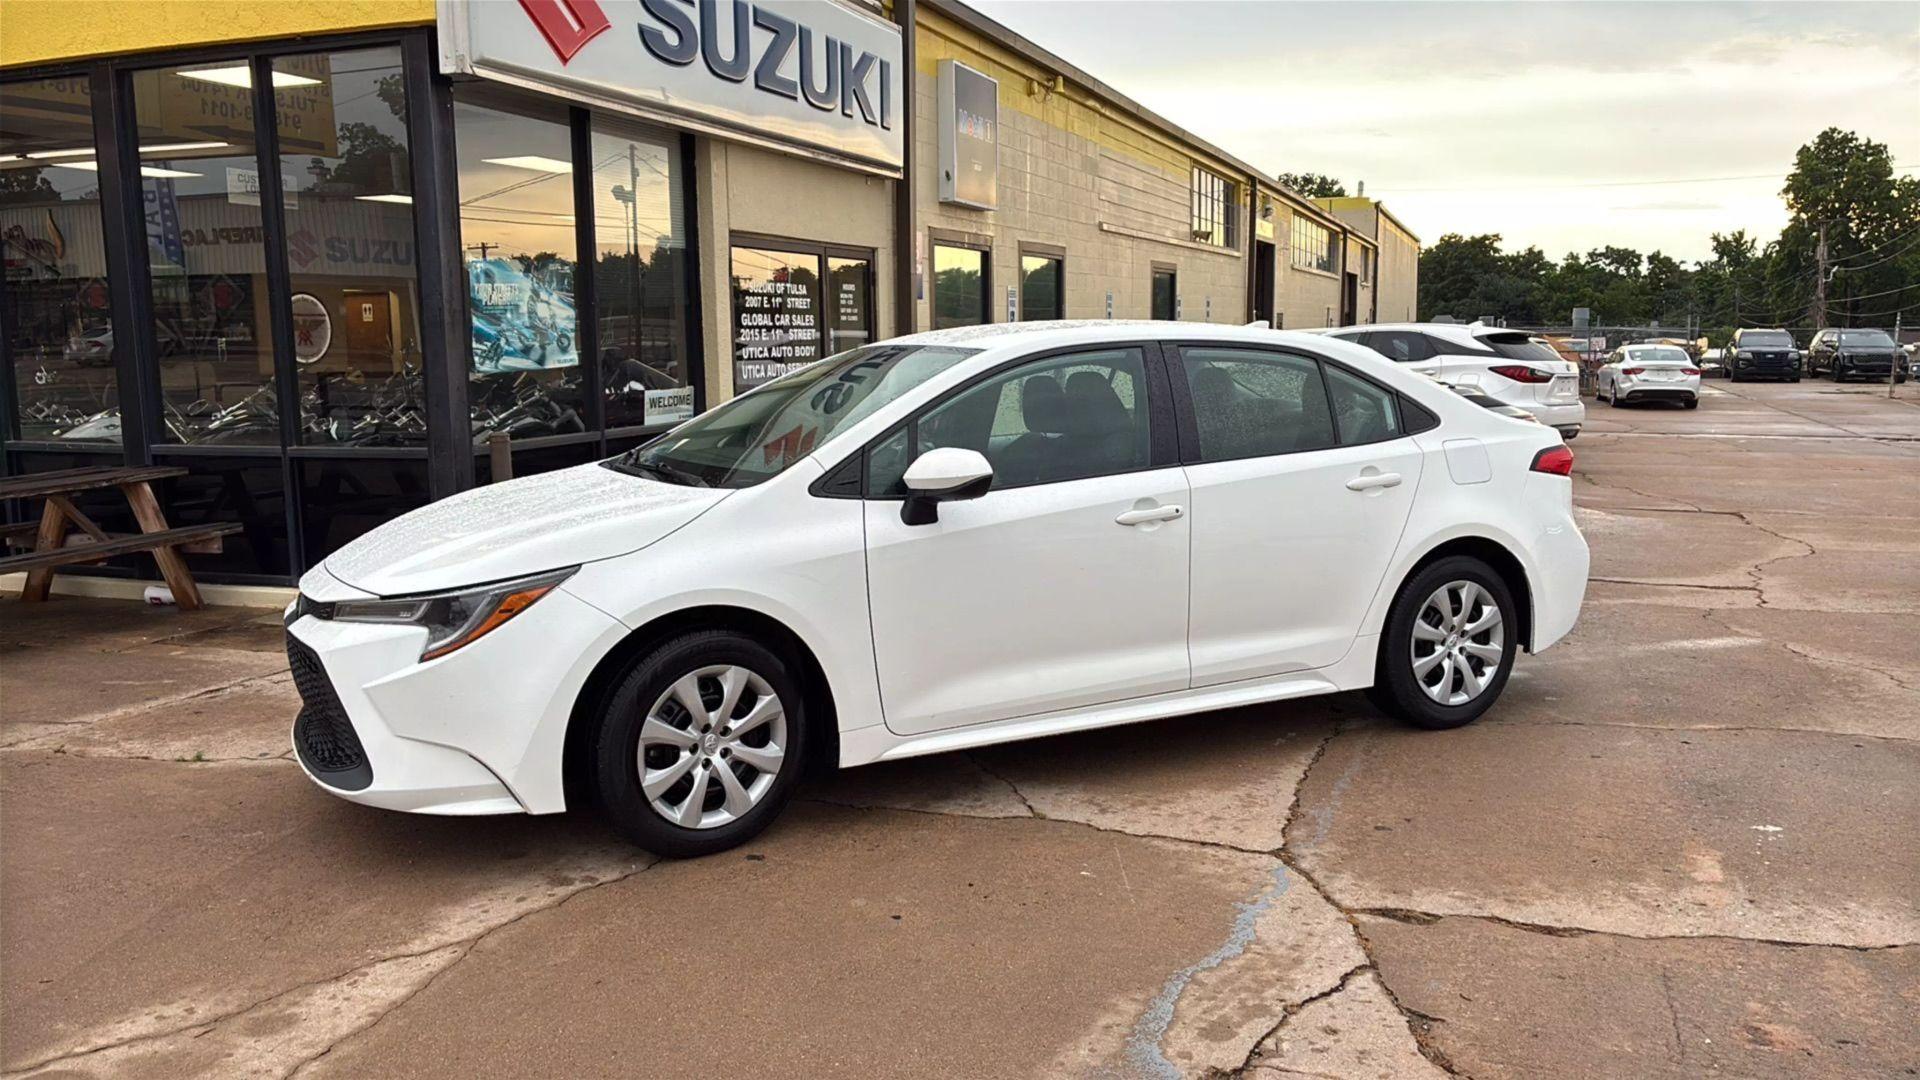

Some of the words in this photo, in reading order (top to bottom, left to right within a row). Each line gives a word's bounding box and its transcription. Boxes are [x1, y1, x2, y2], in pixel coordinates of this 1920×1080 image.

[637, 0, 891, 131] SUZUKI
[325, 238, 414, 265] SUZU
[748, 282, 775, 294] SUZUKI
[776, 283, 785, 294] OF
[786, 283, 808, 295] TULSA
[745, 296, 762, 308] 2007
[763, 296, 771, 308] E.
[787, 298, 811, 309] STREET
[741, 313, 773, 326] GLOBAL
[774, 314, 790, 326] CAR
[792, 314, 815, 326] SALES
[740, 328, 760, 341] 2015
[761, 328, 770, 341] E.
[788, 328, 816, 341] STREET
[742, 346, 769, 359] UTICA
[771, 346, 793, 358] AUTO
[794, 346, 816, 357] BODY
[742, 363, 766, 379] UTICA
[767, 363, 786, 377] AUTO
[649, 394, 691, 409] WELCOME
